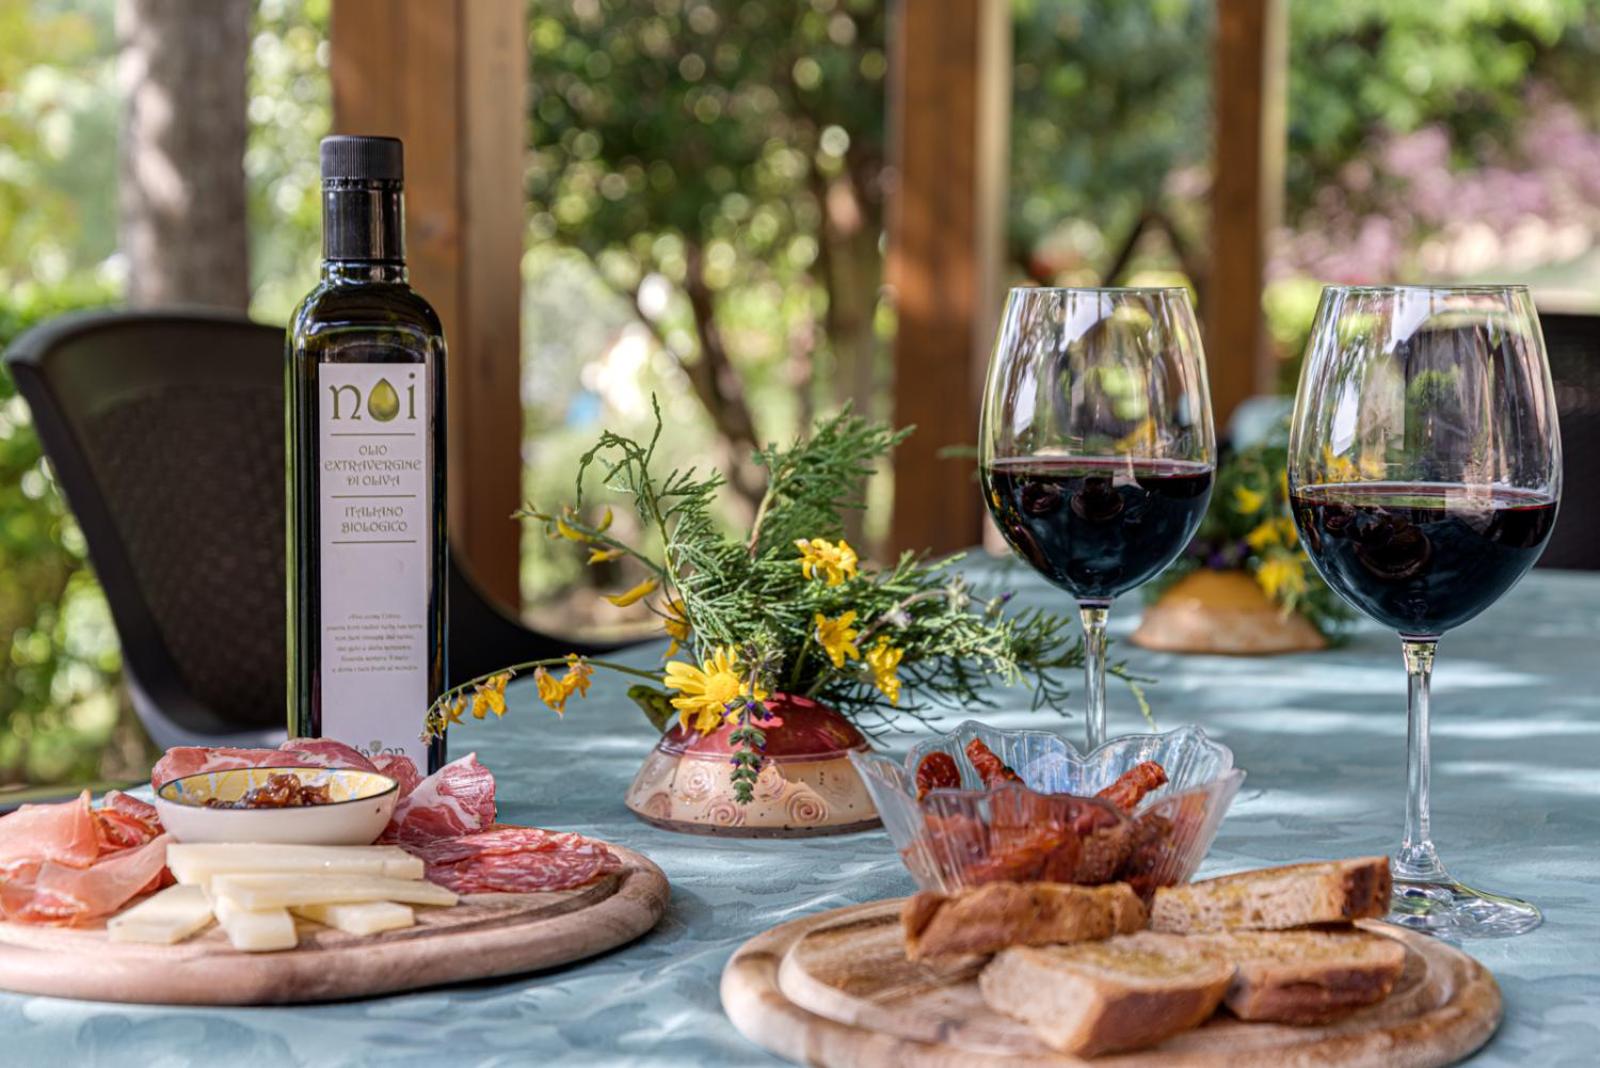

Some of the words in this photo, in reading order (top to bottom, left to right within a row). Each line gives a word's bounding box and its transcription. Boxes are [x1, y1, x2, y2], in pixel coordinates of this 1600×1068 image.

[358, 444, 388, 456] OLIO
[347, 475, 359, 486] DI
[362, 475, 400, 487] OLIVA
[344, 505, 404, 518] ITALIANO
[341, 521, 408, 534] BIOLOGICO
